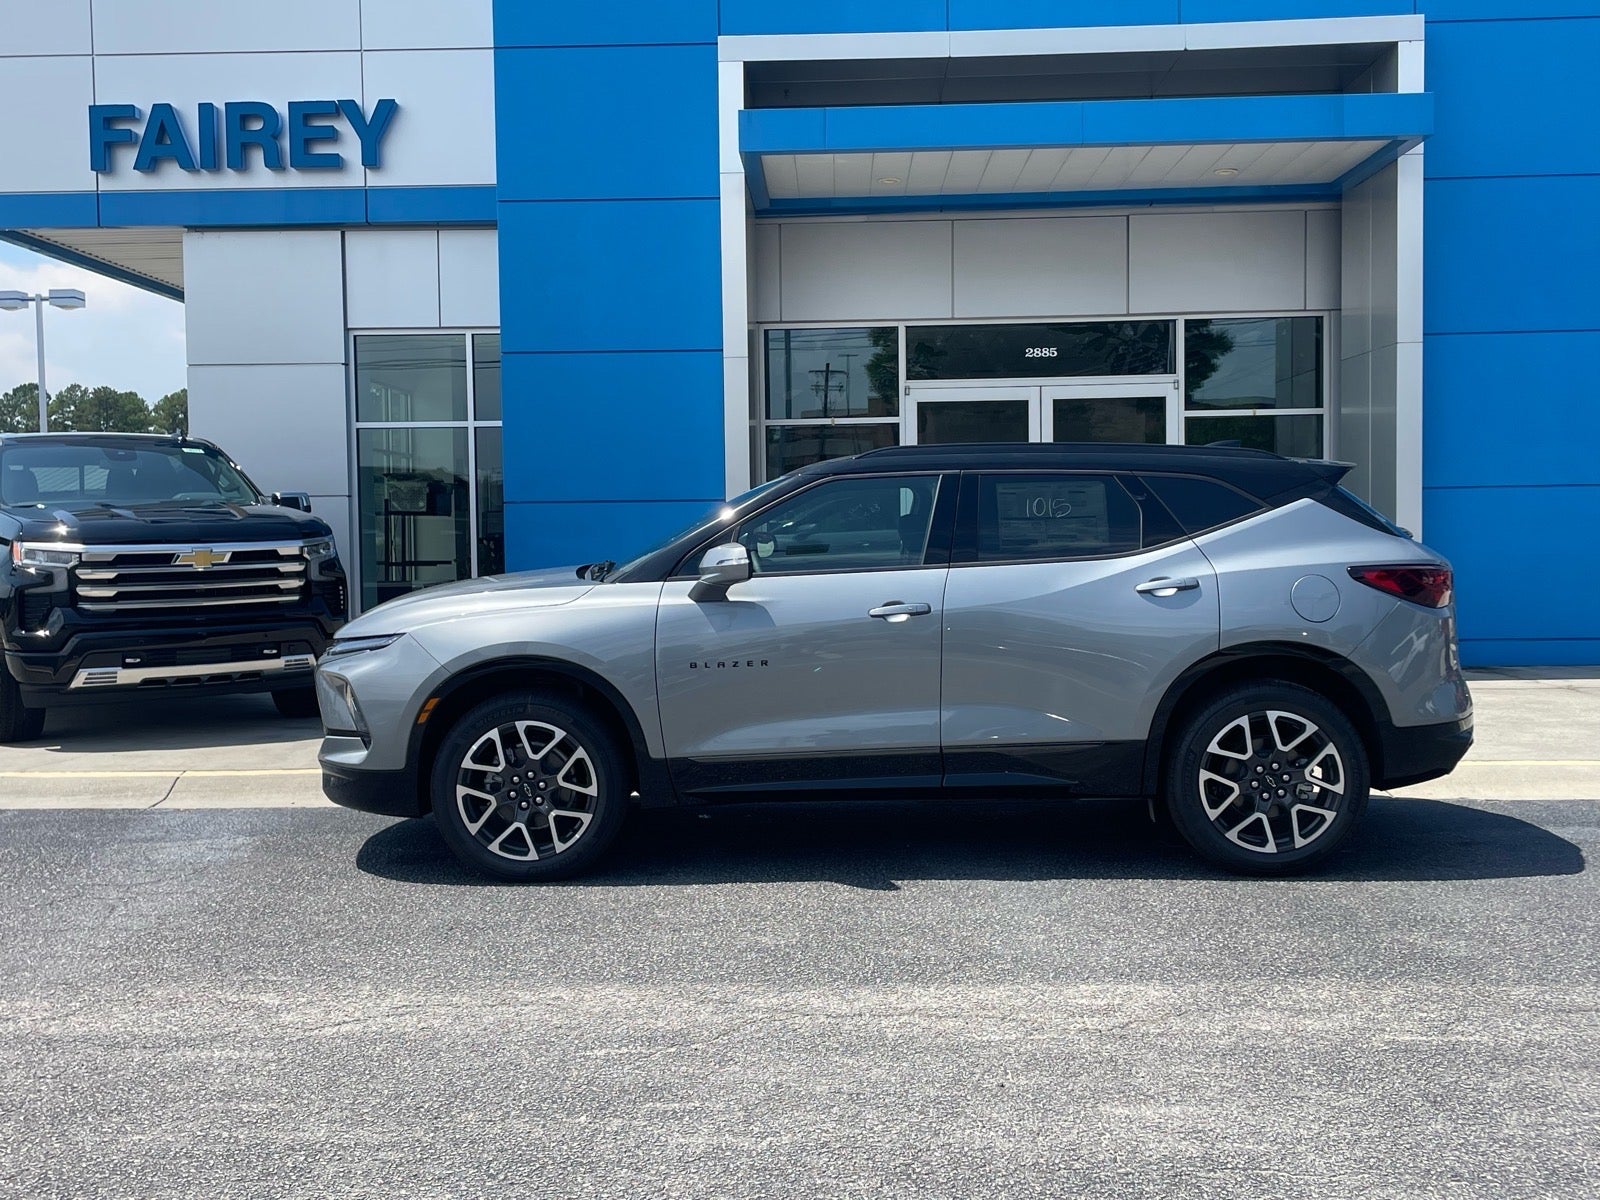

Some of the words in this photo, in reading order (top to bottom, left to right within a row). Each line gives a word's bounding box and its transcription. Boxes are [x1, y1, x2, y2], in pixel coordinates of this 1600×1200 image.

[88, 98, 397, 172] FAIREY
[1025, 347, 1058, 358] 2885
[1026, 497, 1072, 518] 1015
[689, 659, 769, 669] BLAZER
